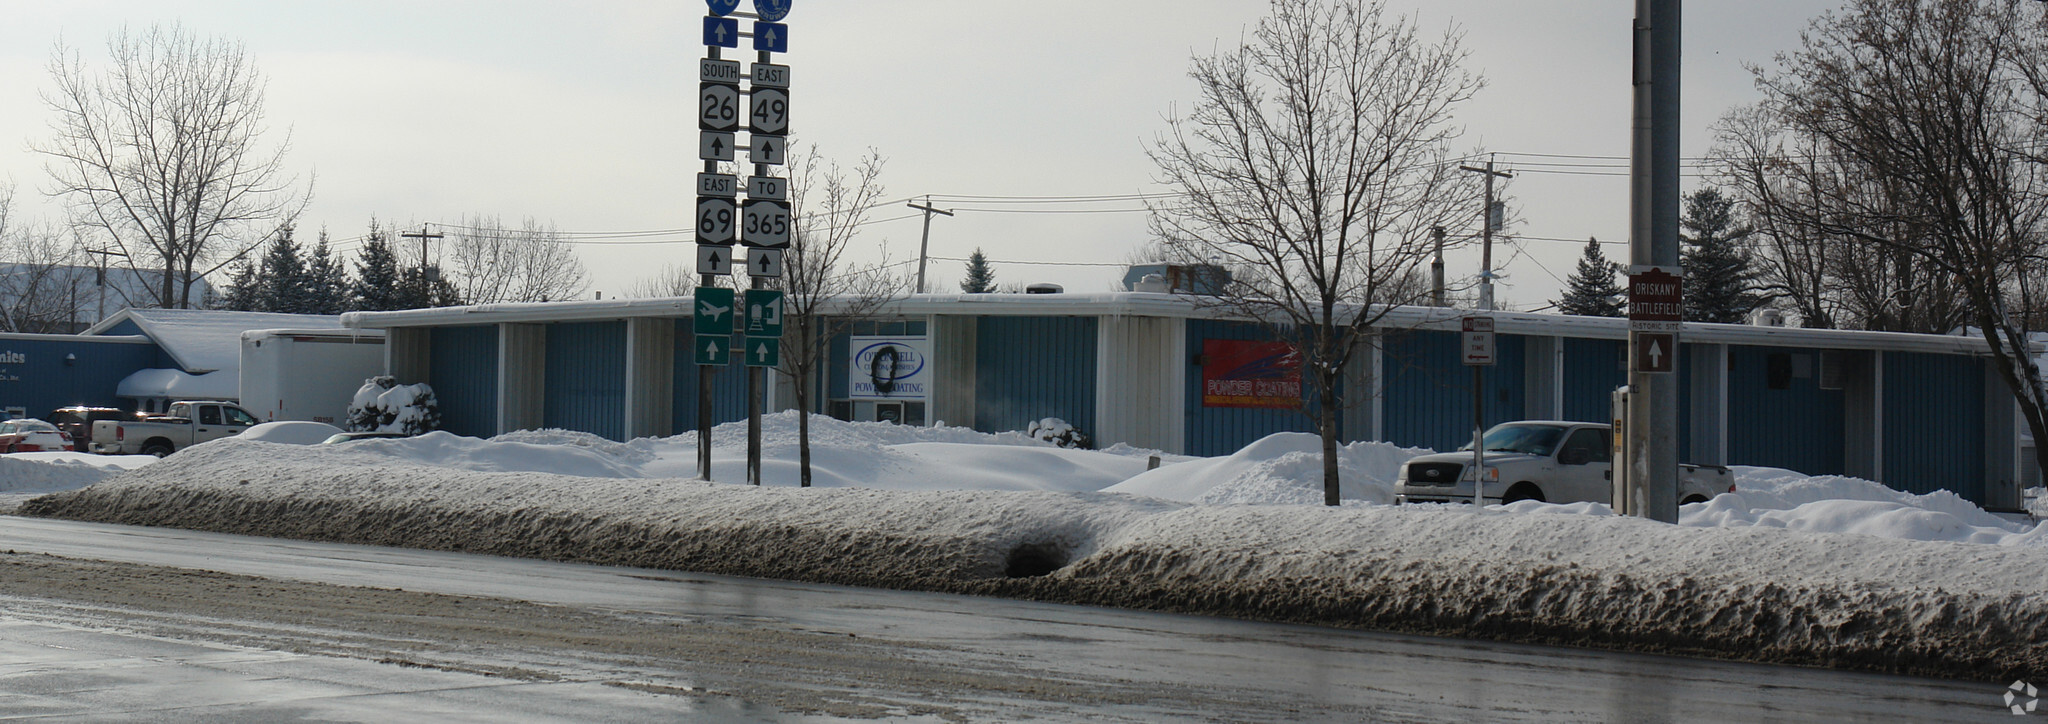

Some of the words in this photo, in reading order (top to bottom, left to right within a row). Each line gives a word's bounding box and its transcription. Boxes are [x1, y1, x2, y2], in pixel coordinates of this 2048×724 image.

[703, 63, 737, 79] SOUTH
[757, 68, 783, 83] EAST
[704, 94, 735, 121] 26
[753, 99, 786, 124] 49
[704, 178, 731, 192] EAST
[758, 181, 776, 195] TO
[700, 208, 732, 234] 69
[746, 212, 787, 236] 365
[1635, 282, 1676, 296] ORISKANY
[1630, 302, 1681, 315] BATTLEFIELD
[1464, 319, 1473, 329] NO
[1632, 321, 1662, 330] HISTORIC
[892, 382, 924, 393] OATING
[1207, 379, 1253, 396] POWDER
[1255, 381, 1301, 398] COATING
